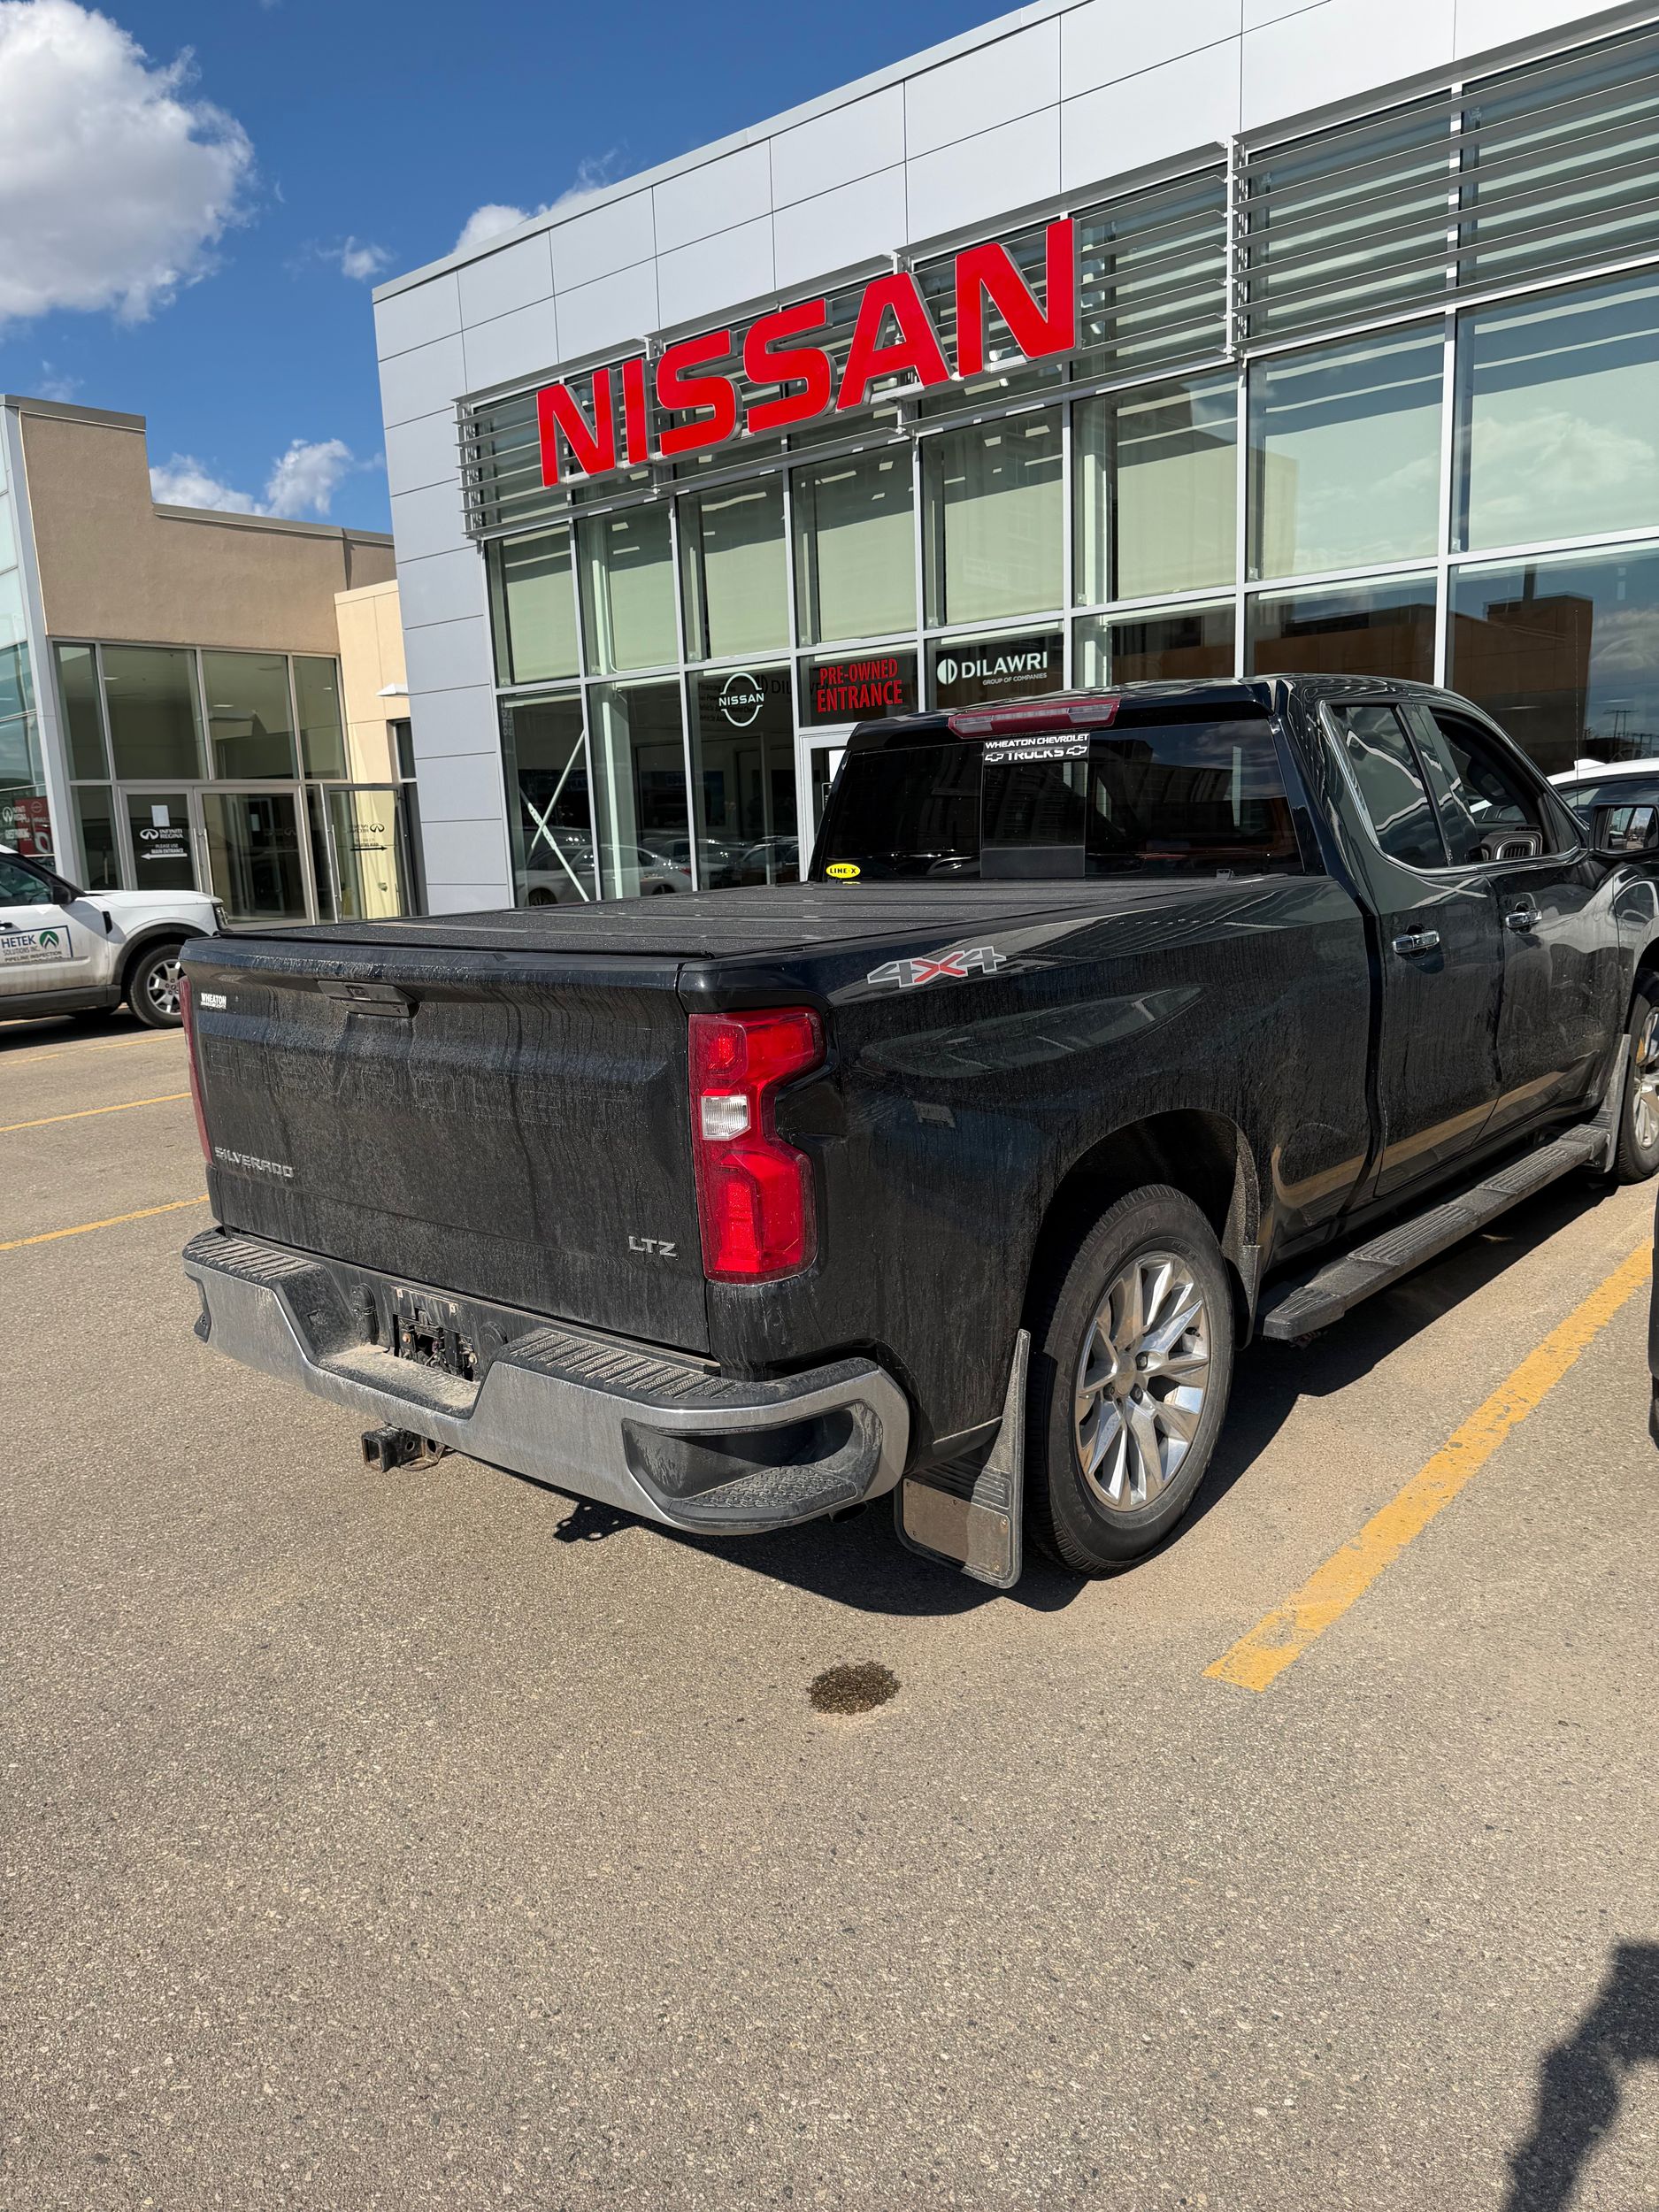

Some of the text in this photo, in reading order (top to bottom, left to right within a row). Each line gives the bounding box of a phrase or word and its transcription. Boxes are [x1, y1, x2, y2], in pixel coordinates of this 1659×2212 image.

[536, 218, 1080, 488] NISSAN
[819, 657, 898, 686] PRE-OWNED
[961, 651, 1048, 679] DILAWRI
[1013, 672, 1048, 682] COMPANIES
[718, 693, 764, 706] NISSAN
[816, 680, 903, 713] ENTRANCE
[985, 733, 1089, 749] WHEATON CHEVROLET
[1008, 749, 1064, 761] TRUCKS
[1, 934, 36, 949] HETEK
[201, 992, 227, 1006] WHEATON
[214, 1147, 295, 1178] SILVERADO
[628, 1235, 678, 1257] LTZ
